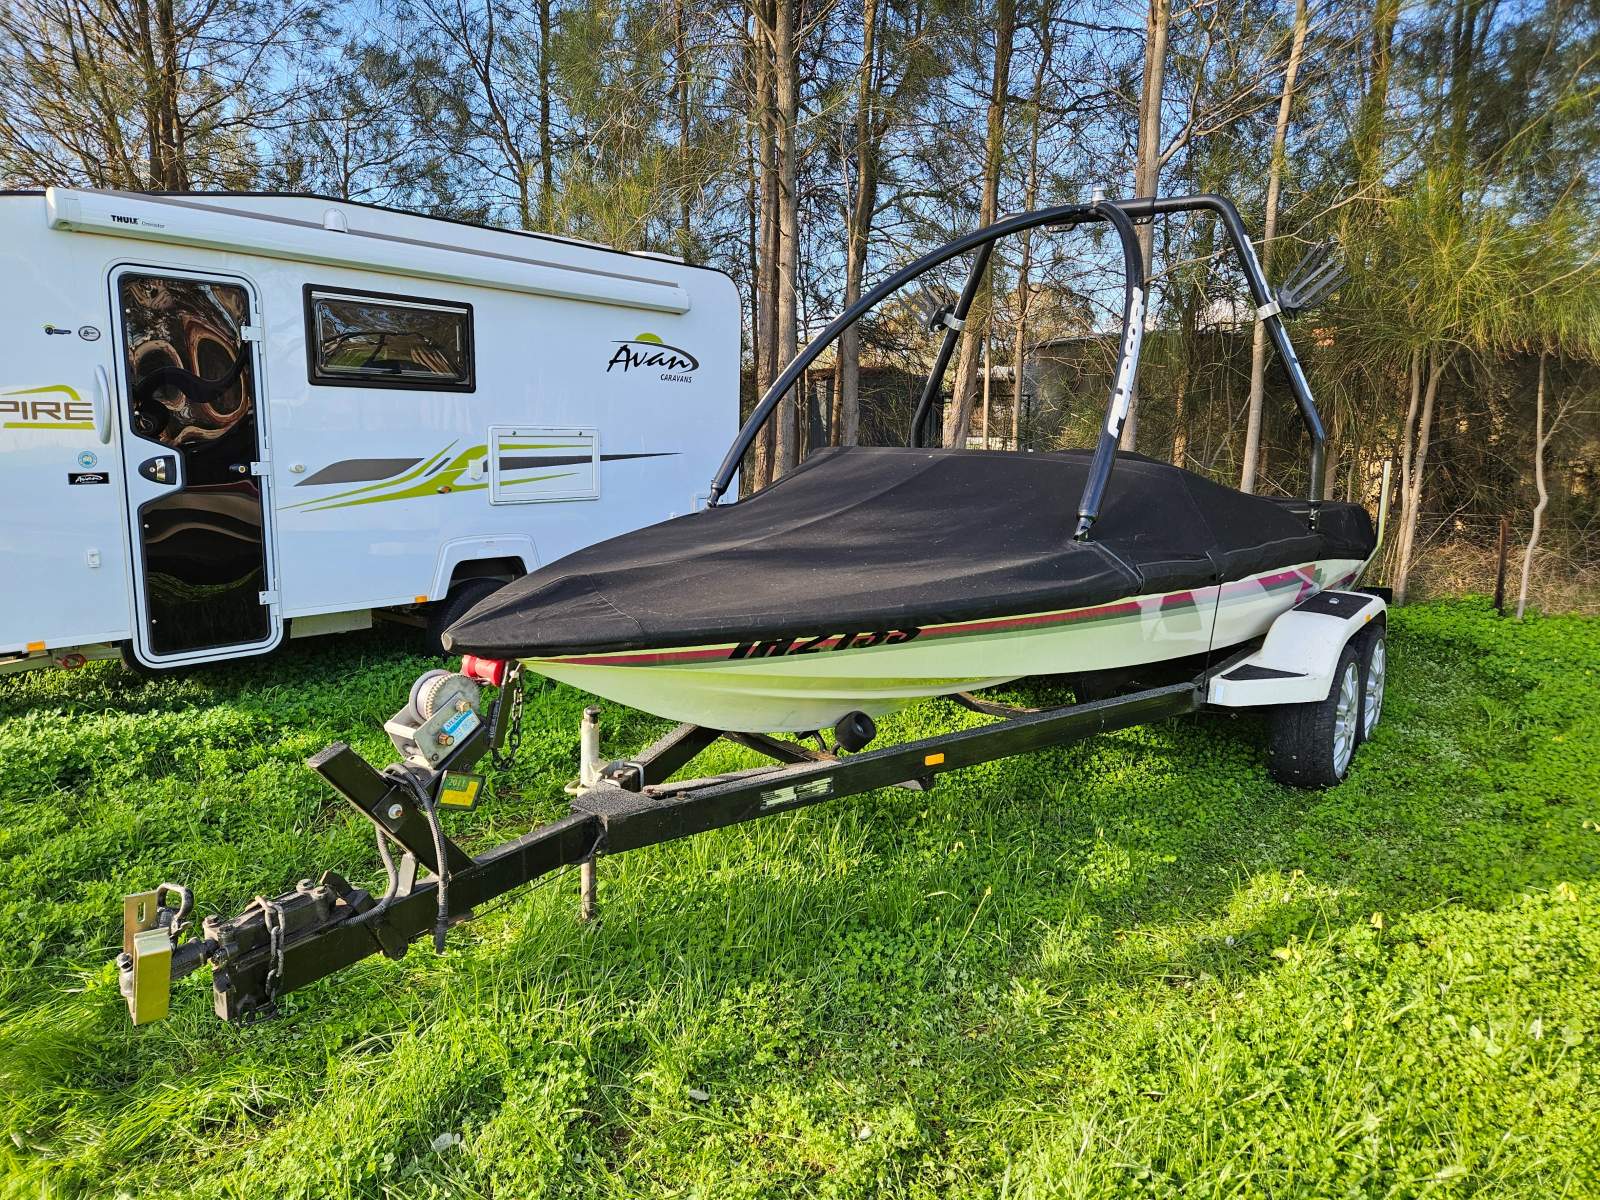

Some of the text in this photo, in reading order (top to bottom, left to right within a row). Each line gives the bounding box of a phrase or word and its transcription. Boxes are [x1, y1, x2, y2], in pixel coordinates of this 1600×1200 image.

[110, 214, 138, 225] THULE
[606, 344, 692, 373] Avan
[660, 373, 693, 384] CARAVANS
[0, 400, 94, 421] PIRE
